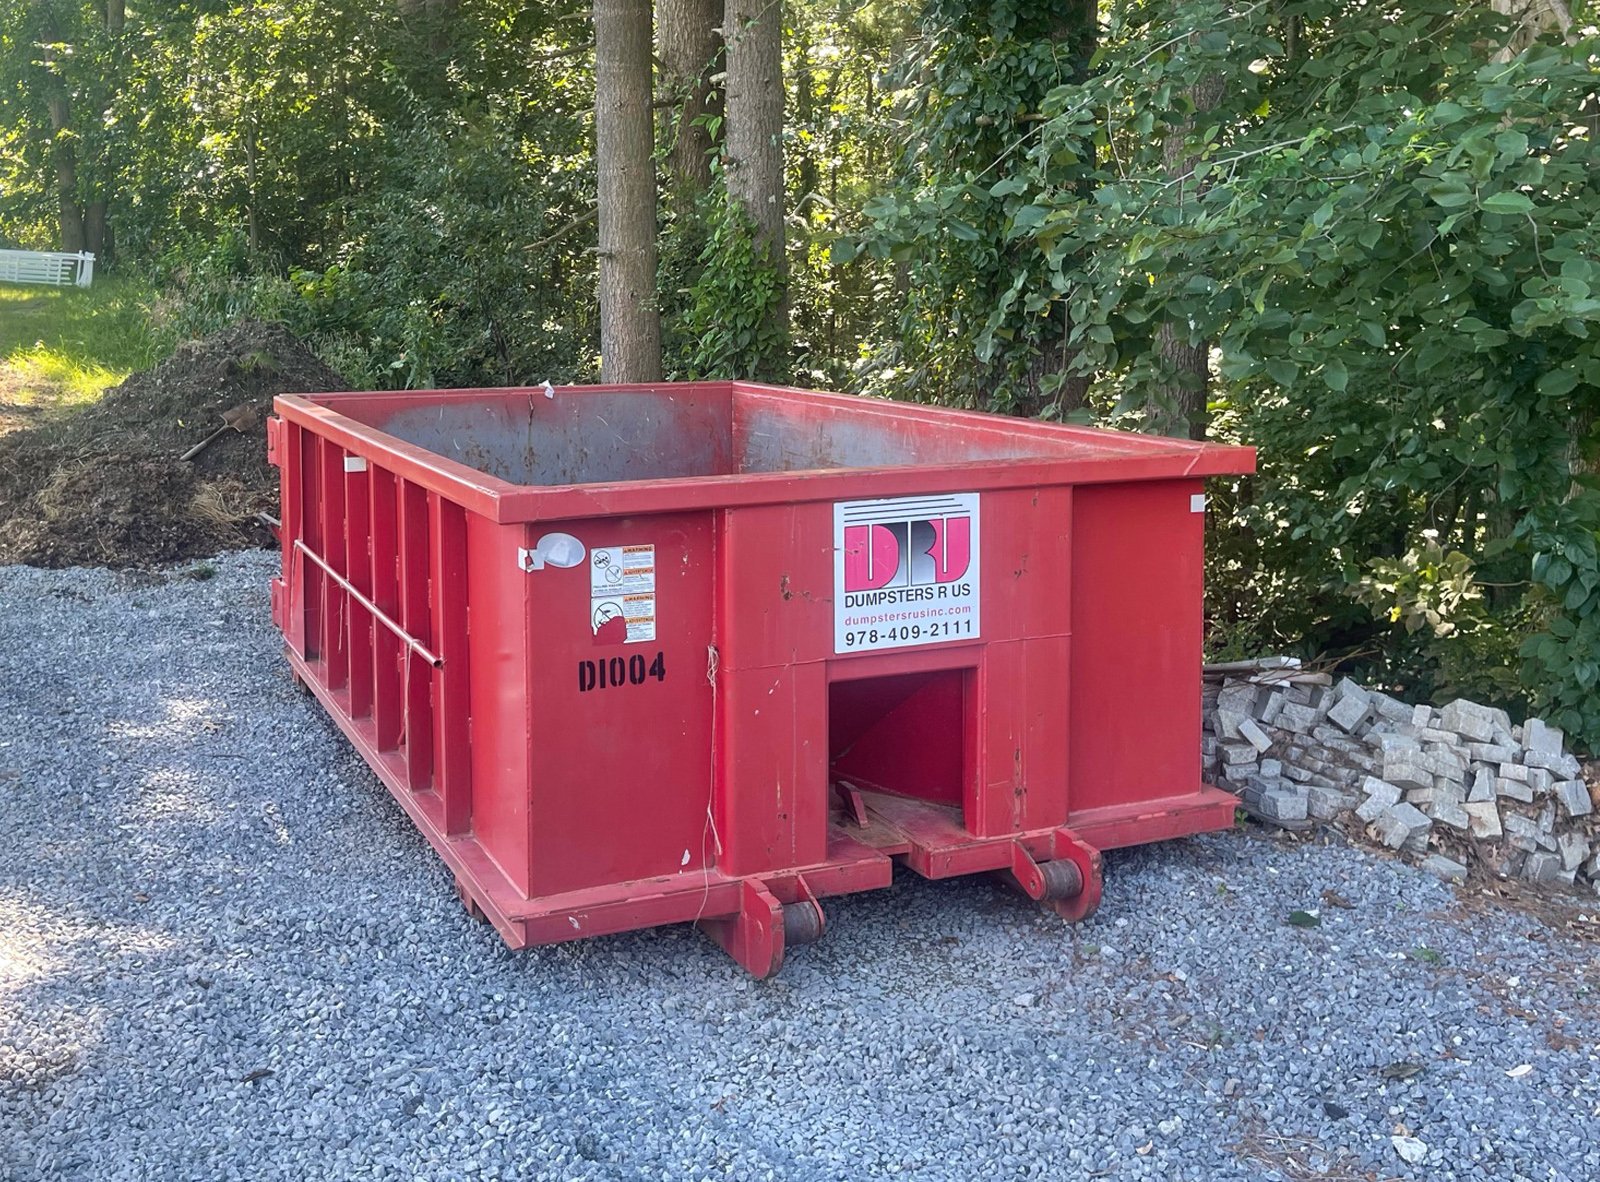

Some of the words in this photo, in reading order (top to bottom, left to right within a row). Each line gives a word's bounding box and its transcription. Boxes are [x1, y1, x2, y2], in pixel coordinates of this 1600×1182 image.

[845, 587, 934, 609] DUMPSTERS
[938, 585, 947, 599] R
[951, 583, 971, 597] US
[844, 605, 972, 626] dumpstersrusinc.com
[845, 619, 972, 646] 978-409-2111
